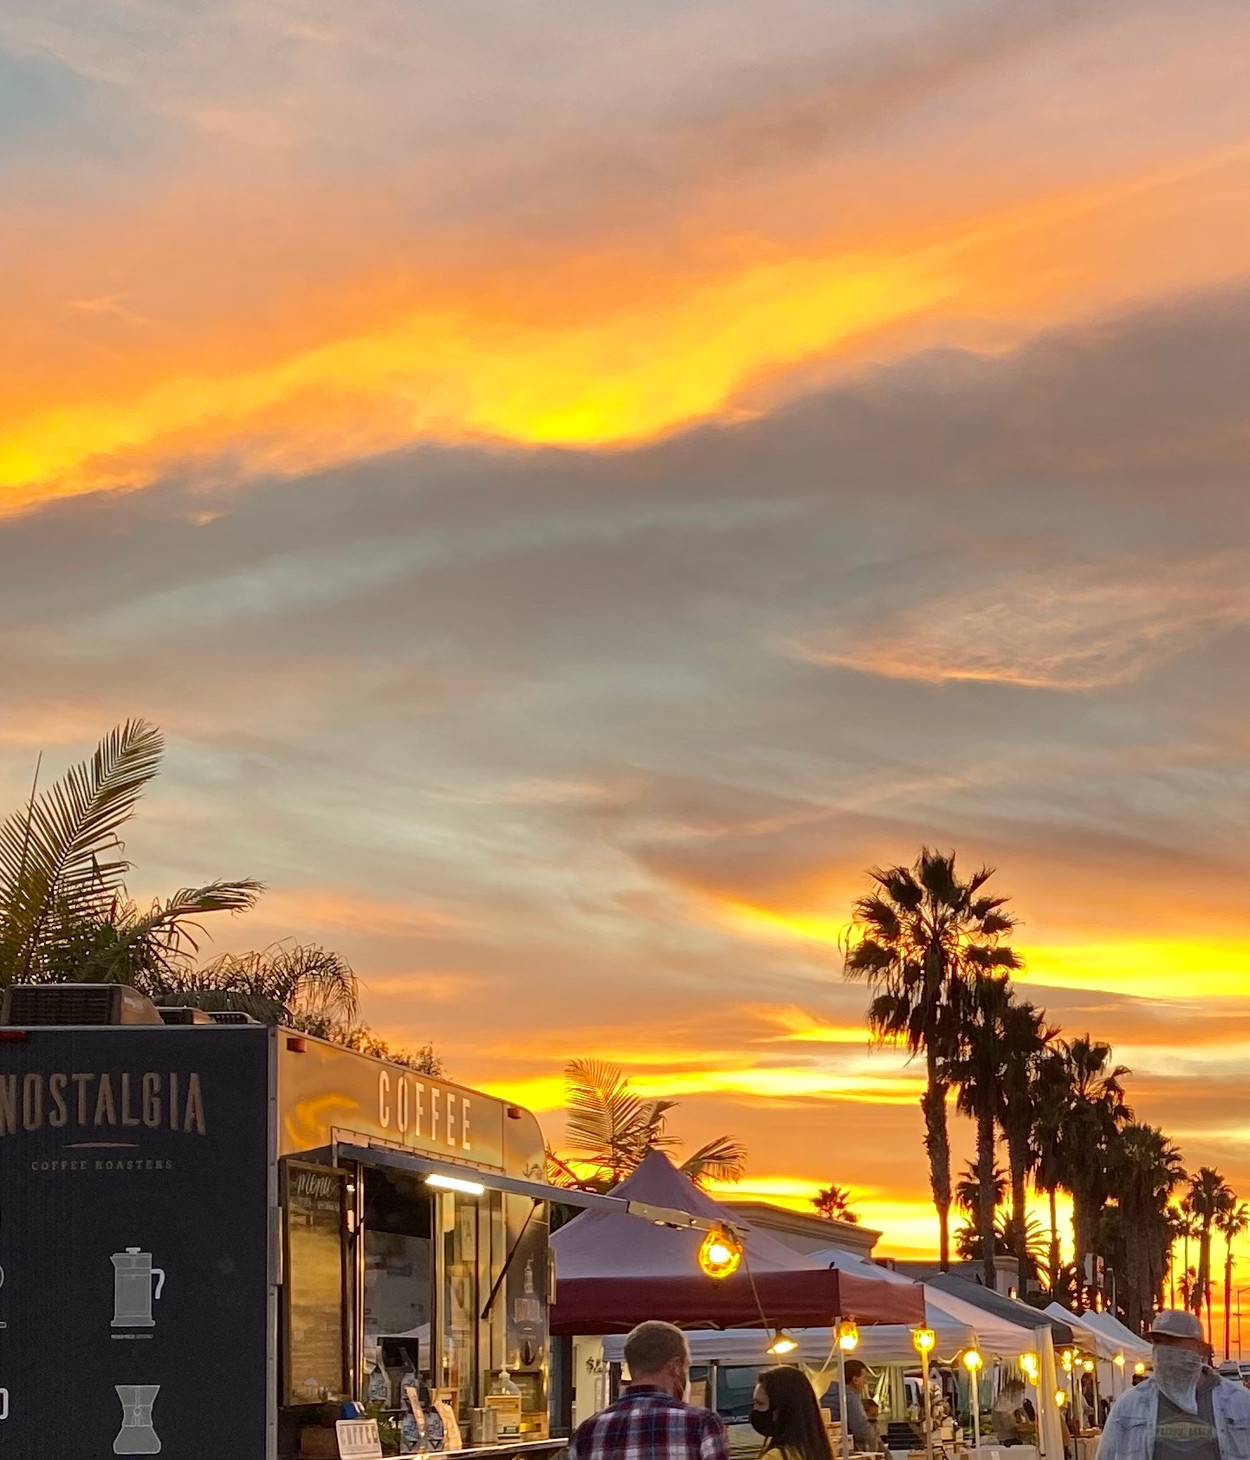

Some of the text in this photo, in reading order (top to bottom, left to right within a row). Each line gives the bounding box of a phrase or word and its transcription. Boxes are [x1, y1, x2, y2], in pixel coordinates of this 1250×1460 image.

[0, 1072, 207, 1137] NOSTALGIA
[378, 1069, 472, 1151] COFFEE
[31, 1159, 174, 1172] COFFEE ROASTERS
